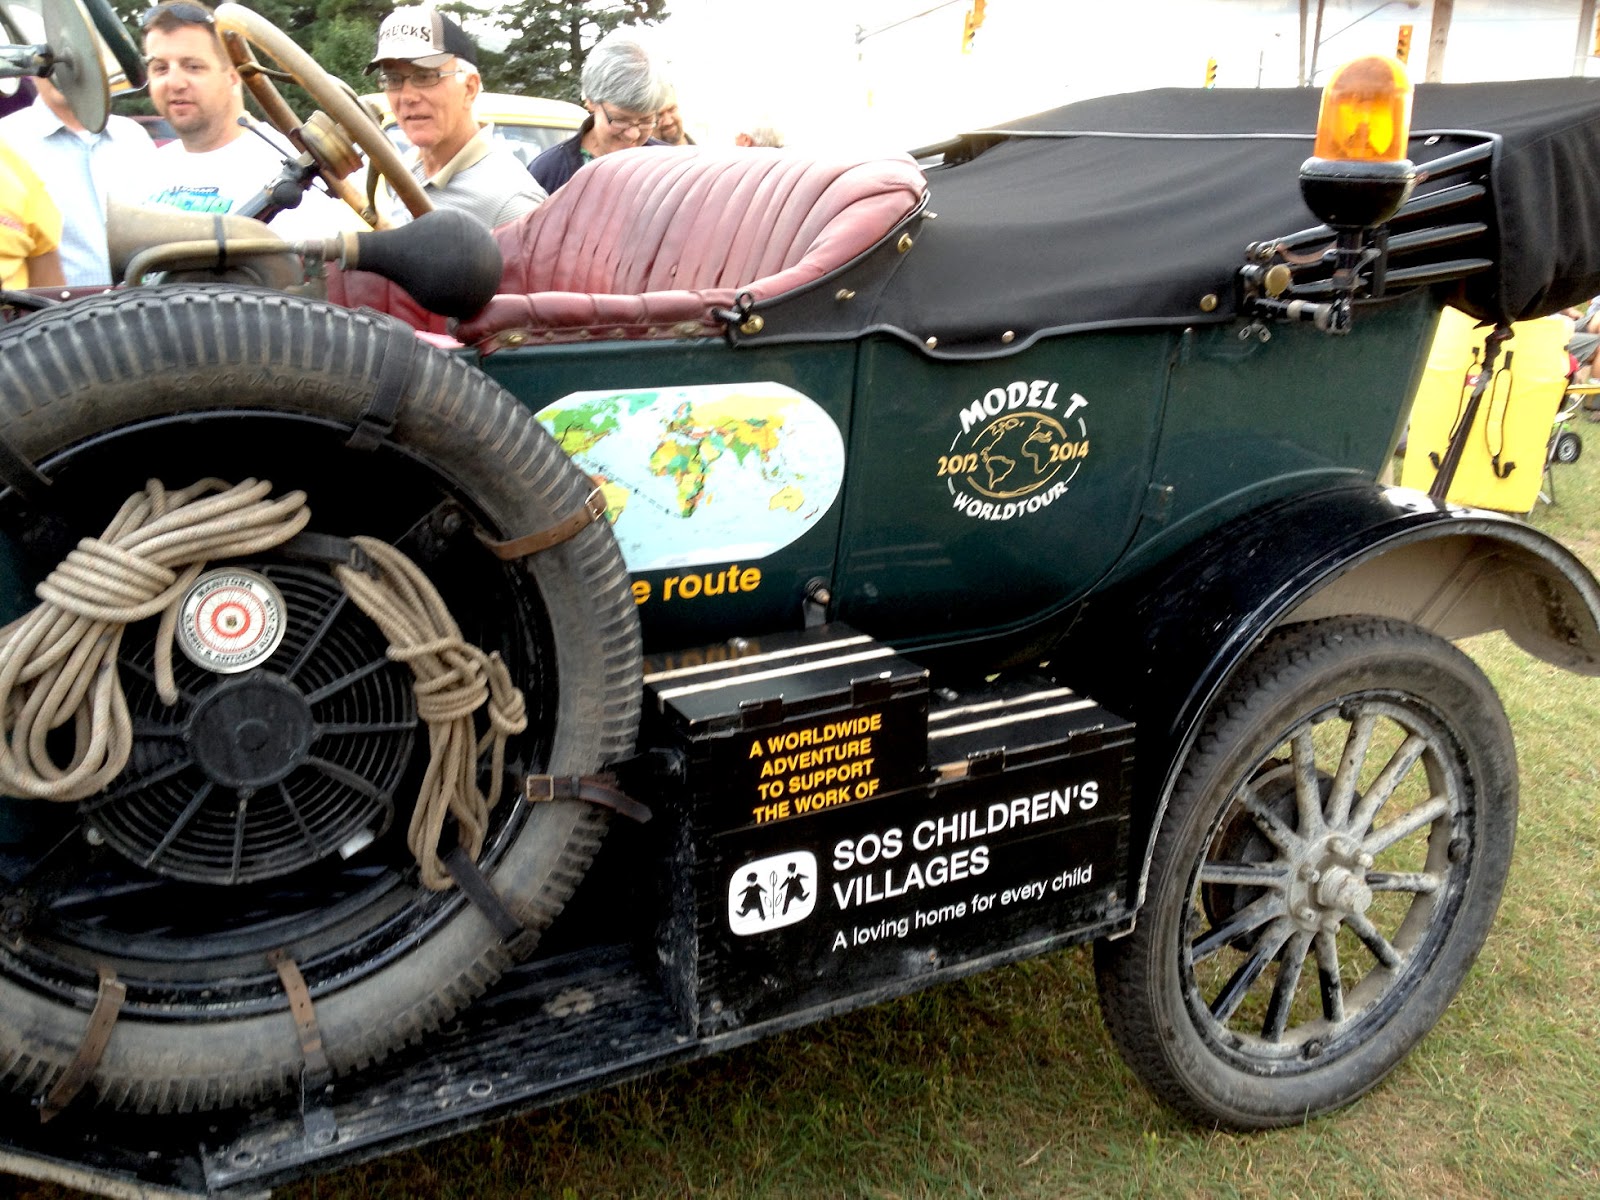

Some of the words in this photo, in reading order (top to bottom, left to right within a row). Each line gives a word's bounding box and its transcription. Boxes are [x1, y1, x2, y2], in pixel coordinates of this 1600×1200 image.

[959, 380, 1060, 434] MODEL
[1063, 393, 1088, 418] T
[937, 452, 979, 476] 2012
[1048, 440, 1090, 463] 2014
[952, 481, 1069, 521] WORLDTOUR
[662, 563, 762, 602] route
[749, 741, 763, 759] A
[767, 713, 882, 752] WORLDWIDE
[760, 739, 872, 777] ADVENTURE
[753, 804, 791, 824] THE
[794, 787, 850, 815] WORK
[854, 778, 881, 800] OF
[758, 781, 784, 801] TO
[788, 758, 874, 795] SUPPORT
[832, 827, 903, 872] SOS
[911, 780, 1099, 853] CHILDREN'S
[832, 845, 991, 911] VILLAGES
[832, 930, 848, 952] A
[852, 918, 910, 949] loving
[914, 902, 967, 931] home
[970, 892, 998, 916] for
[1000, 879, 1048, 911] every
[1051, 864, 1094, 893] child
